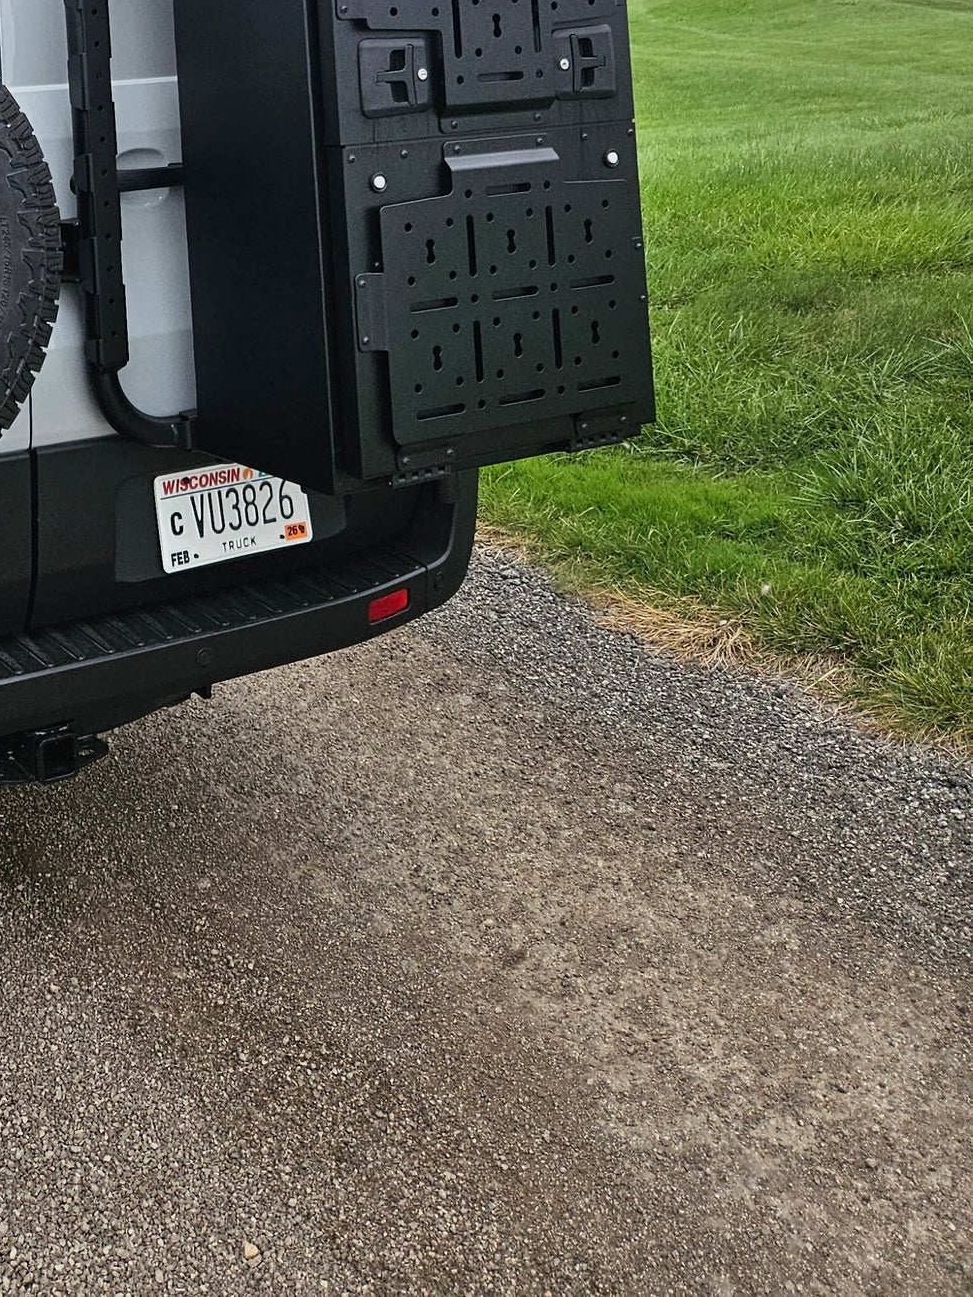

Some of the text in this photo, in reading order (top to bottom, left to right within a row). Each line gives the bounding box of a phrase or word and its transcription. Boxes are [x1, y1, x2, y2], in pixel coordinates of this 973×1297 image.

[162, 468, 240, 495] WISCONSIN
[190, 480, 295, 539] VU3826
[222, 536, 256, 553] TRUCK
[171, 550, 190, 567] FEB
